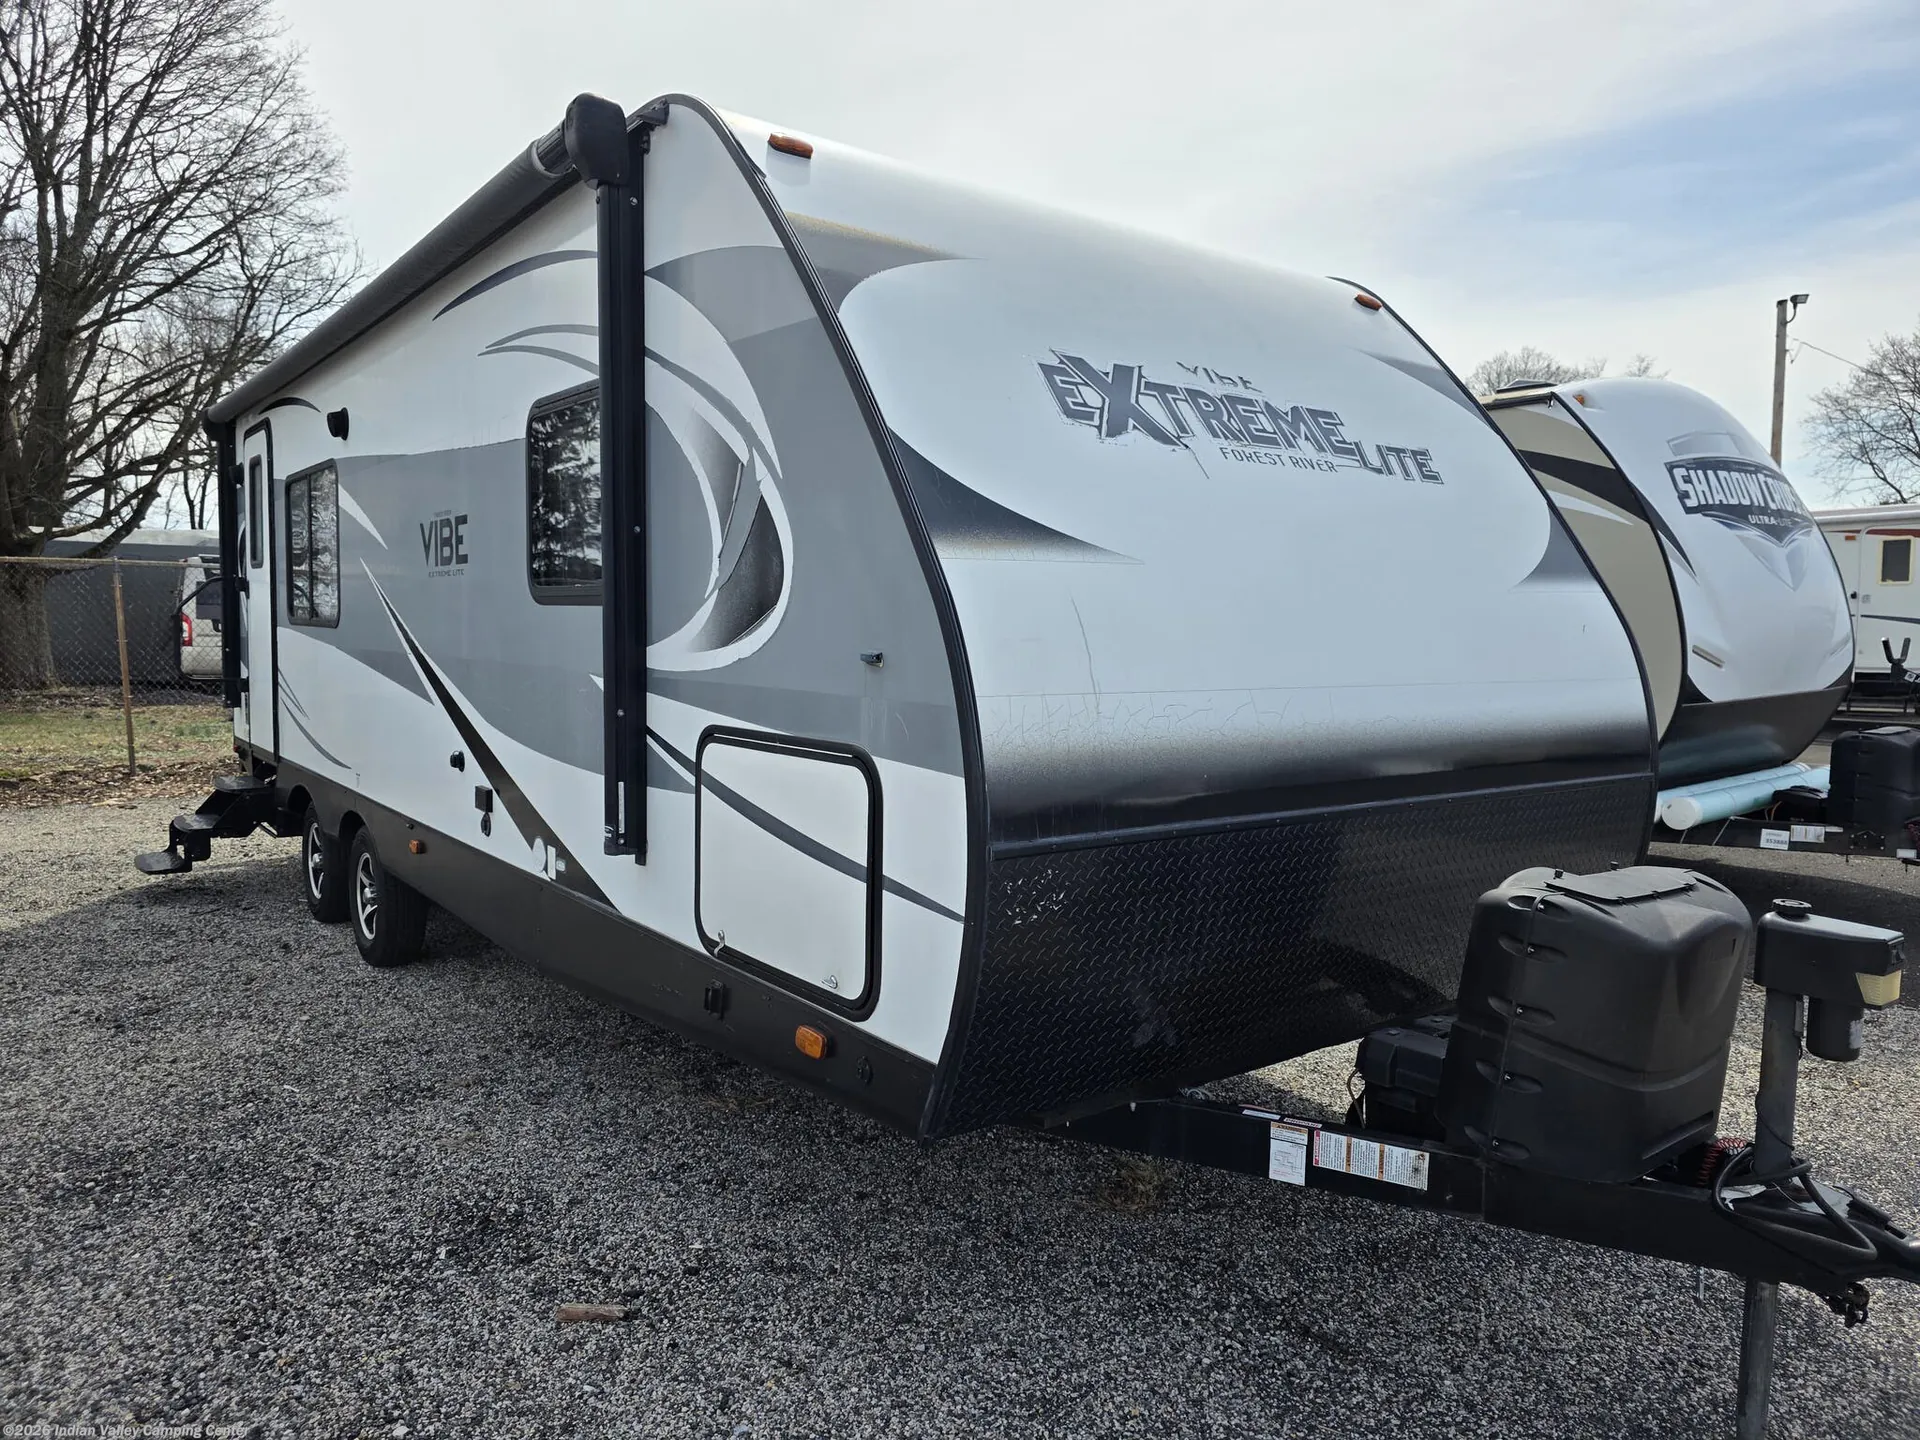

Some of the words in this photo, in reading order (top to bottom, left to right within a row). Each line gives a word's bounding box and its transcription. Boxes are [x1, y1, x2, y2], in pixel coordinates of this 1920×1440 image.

[1036, 348, 1361, 456] EXTREME
[1354, 440, 1444, 485] LITE
[1219, 446, 1286, 467] FOREST
[1288, 455, 1339, 473] RIVER
[420, 514, 468, 567] VIBE
